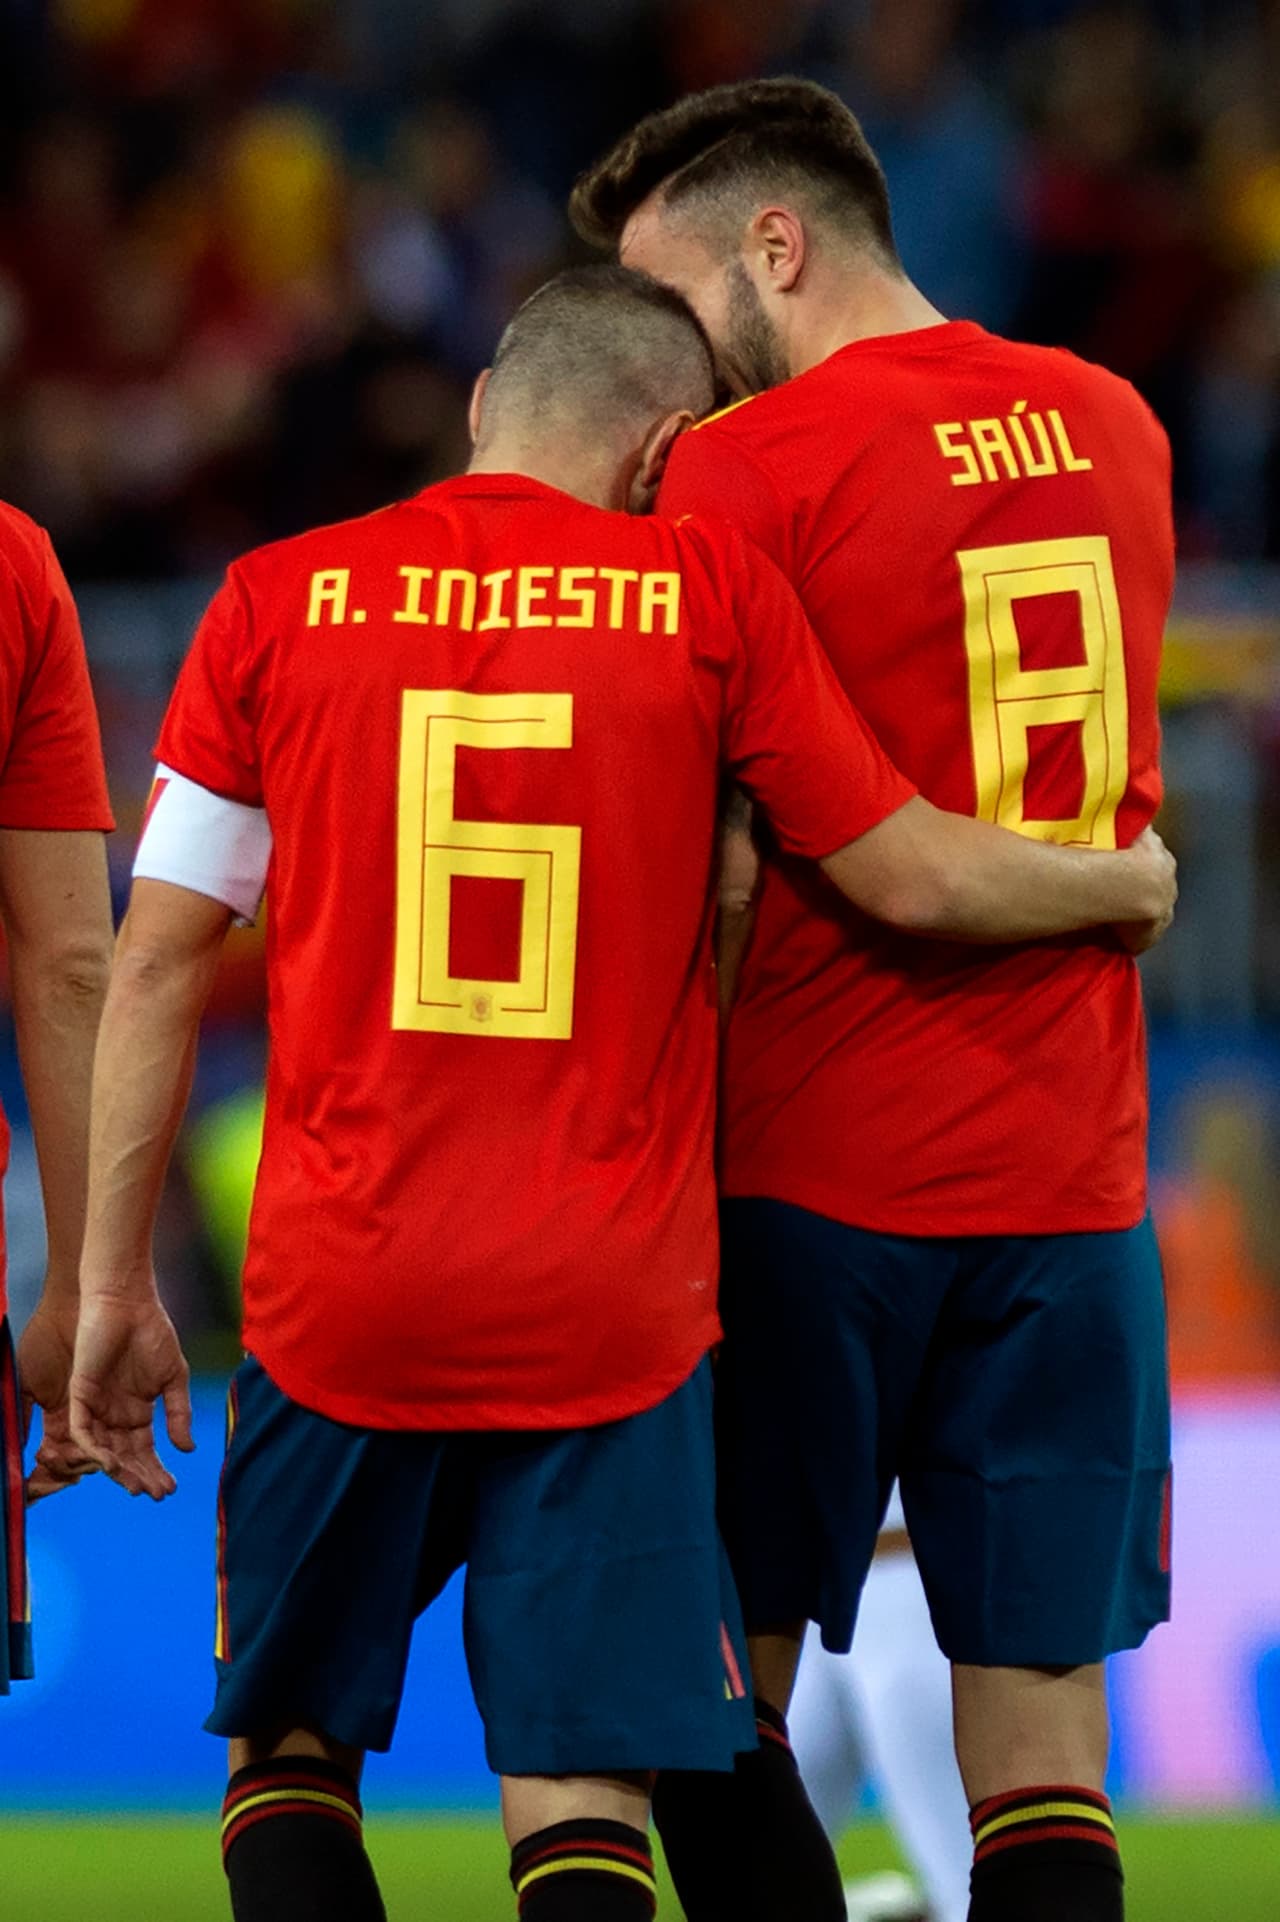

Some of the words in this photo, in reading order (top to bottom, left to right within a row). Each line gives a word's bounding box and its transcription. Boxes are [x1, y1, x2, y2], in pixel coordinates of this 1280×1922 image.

[933, 400, 1093, 486] SAÚL
[307, 568, 367, 627] A.
[393, 565, 681, 635] INIESTA
[956, 535, 1128, 850] 8
[391, 688, 582, 1040] 6
